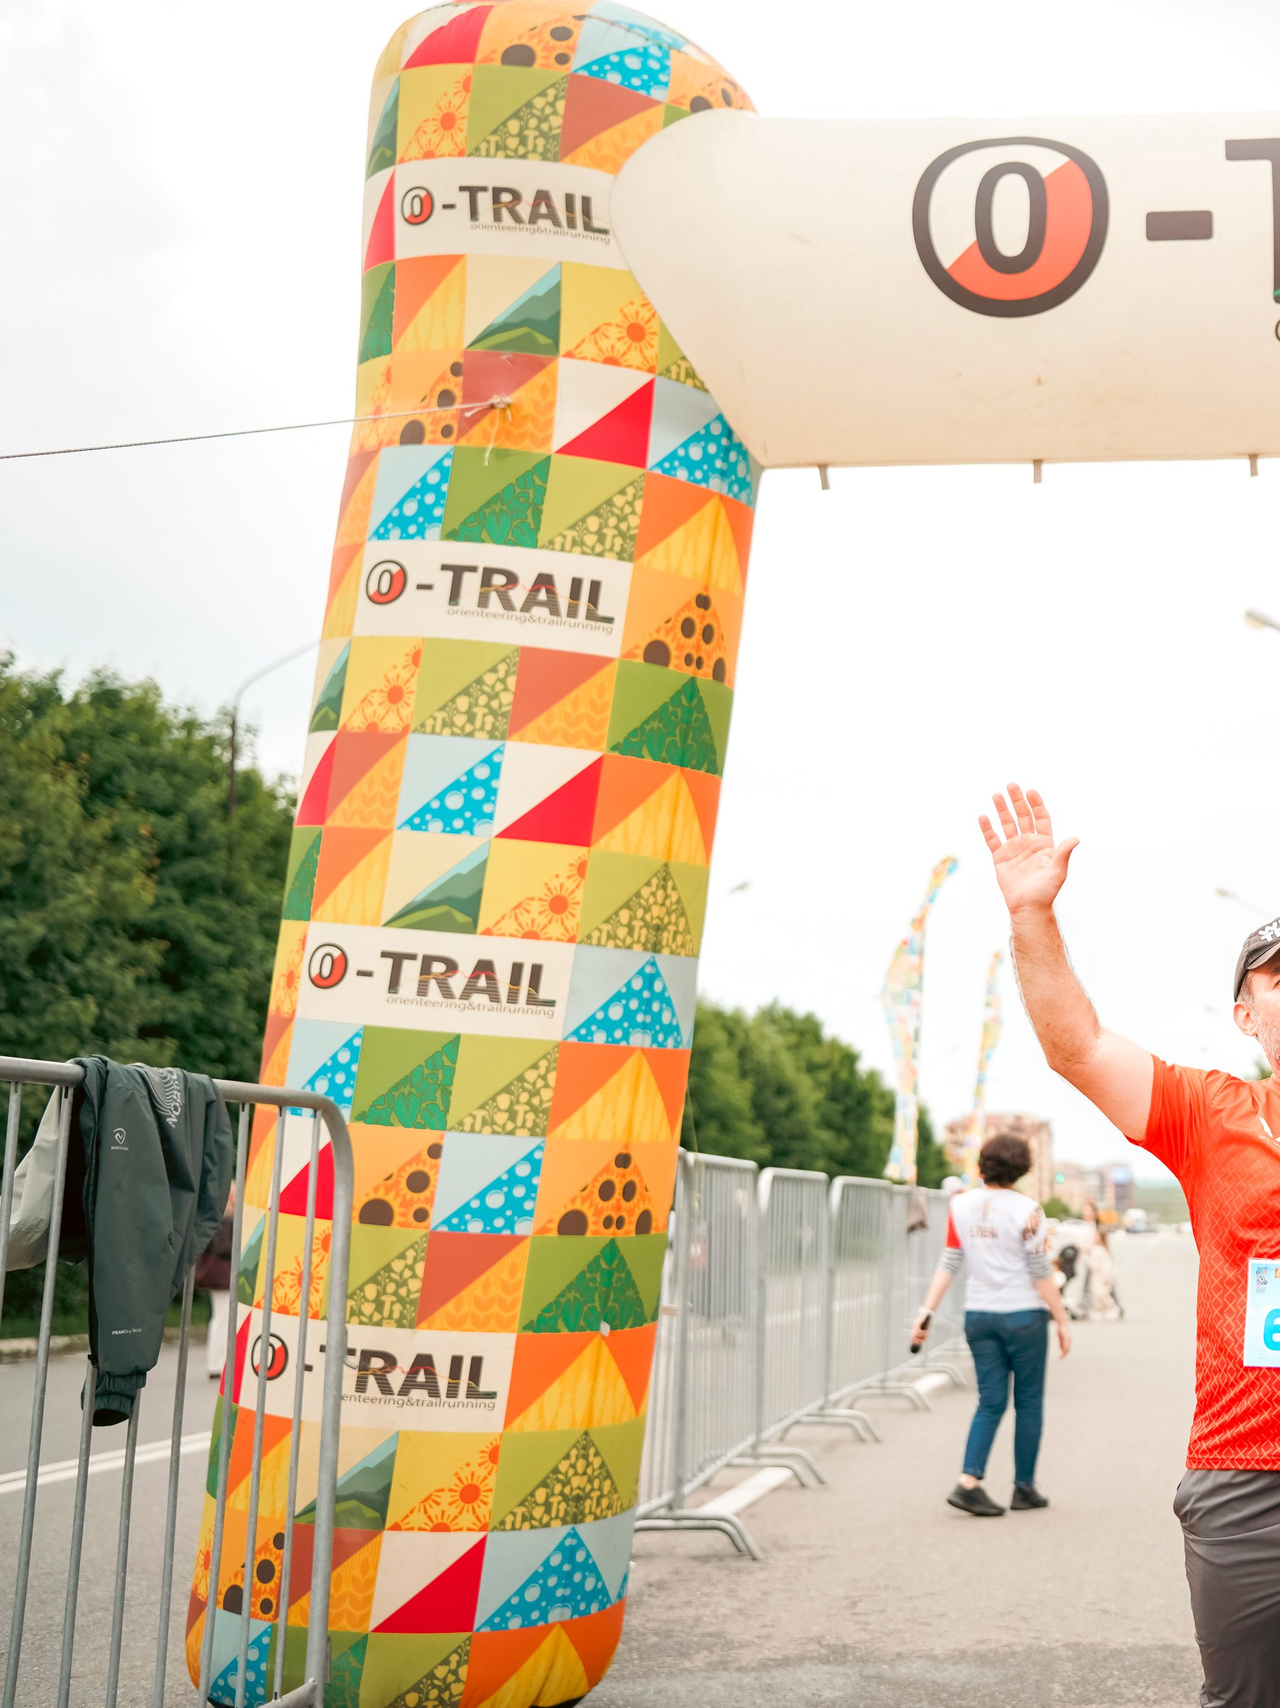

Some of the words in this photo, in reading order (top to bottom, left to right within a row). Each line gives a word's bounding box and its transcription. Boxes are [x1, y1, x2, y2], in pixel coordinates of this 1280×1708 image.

[446, 607, 614, 635] orienteering&trailrunning
[386, 994, 556, 1018] orienteering&trailrunning
[340, 1392, 496, 1411] enteering&trailrunning
